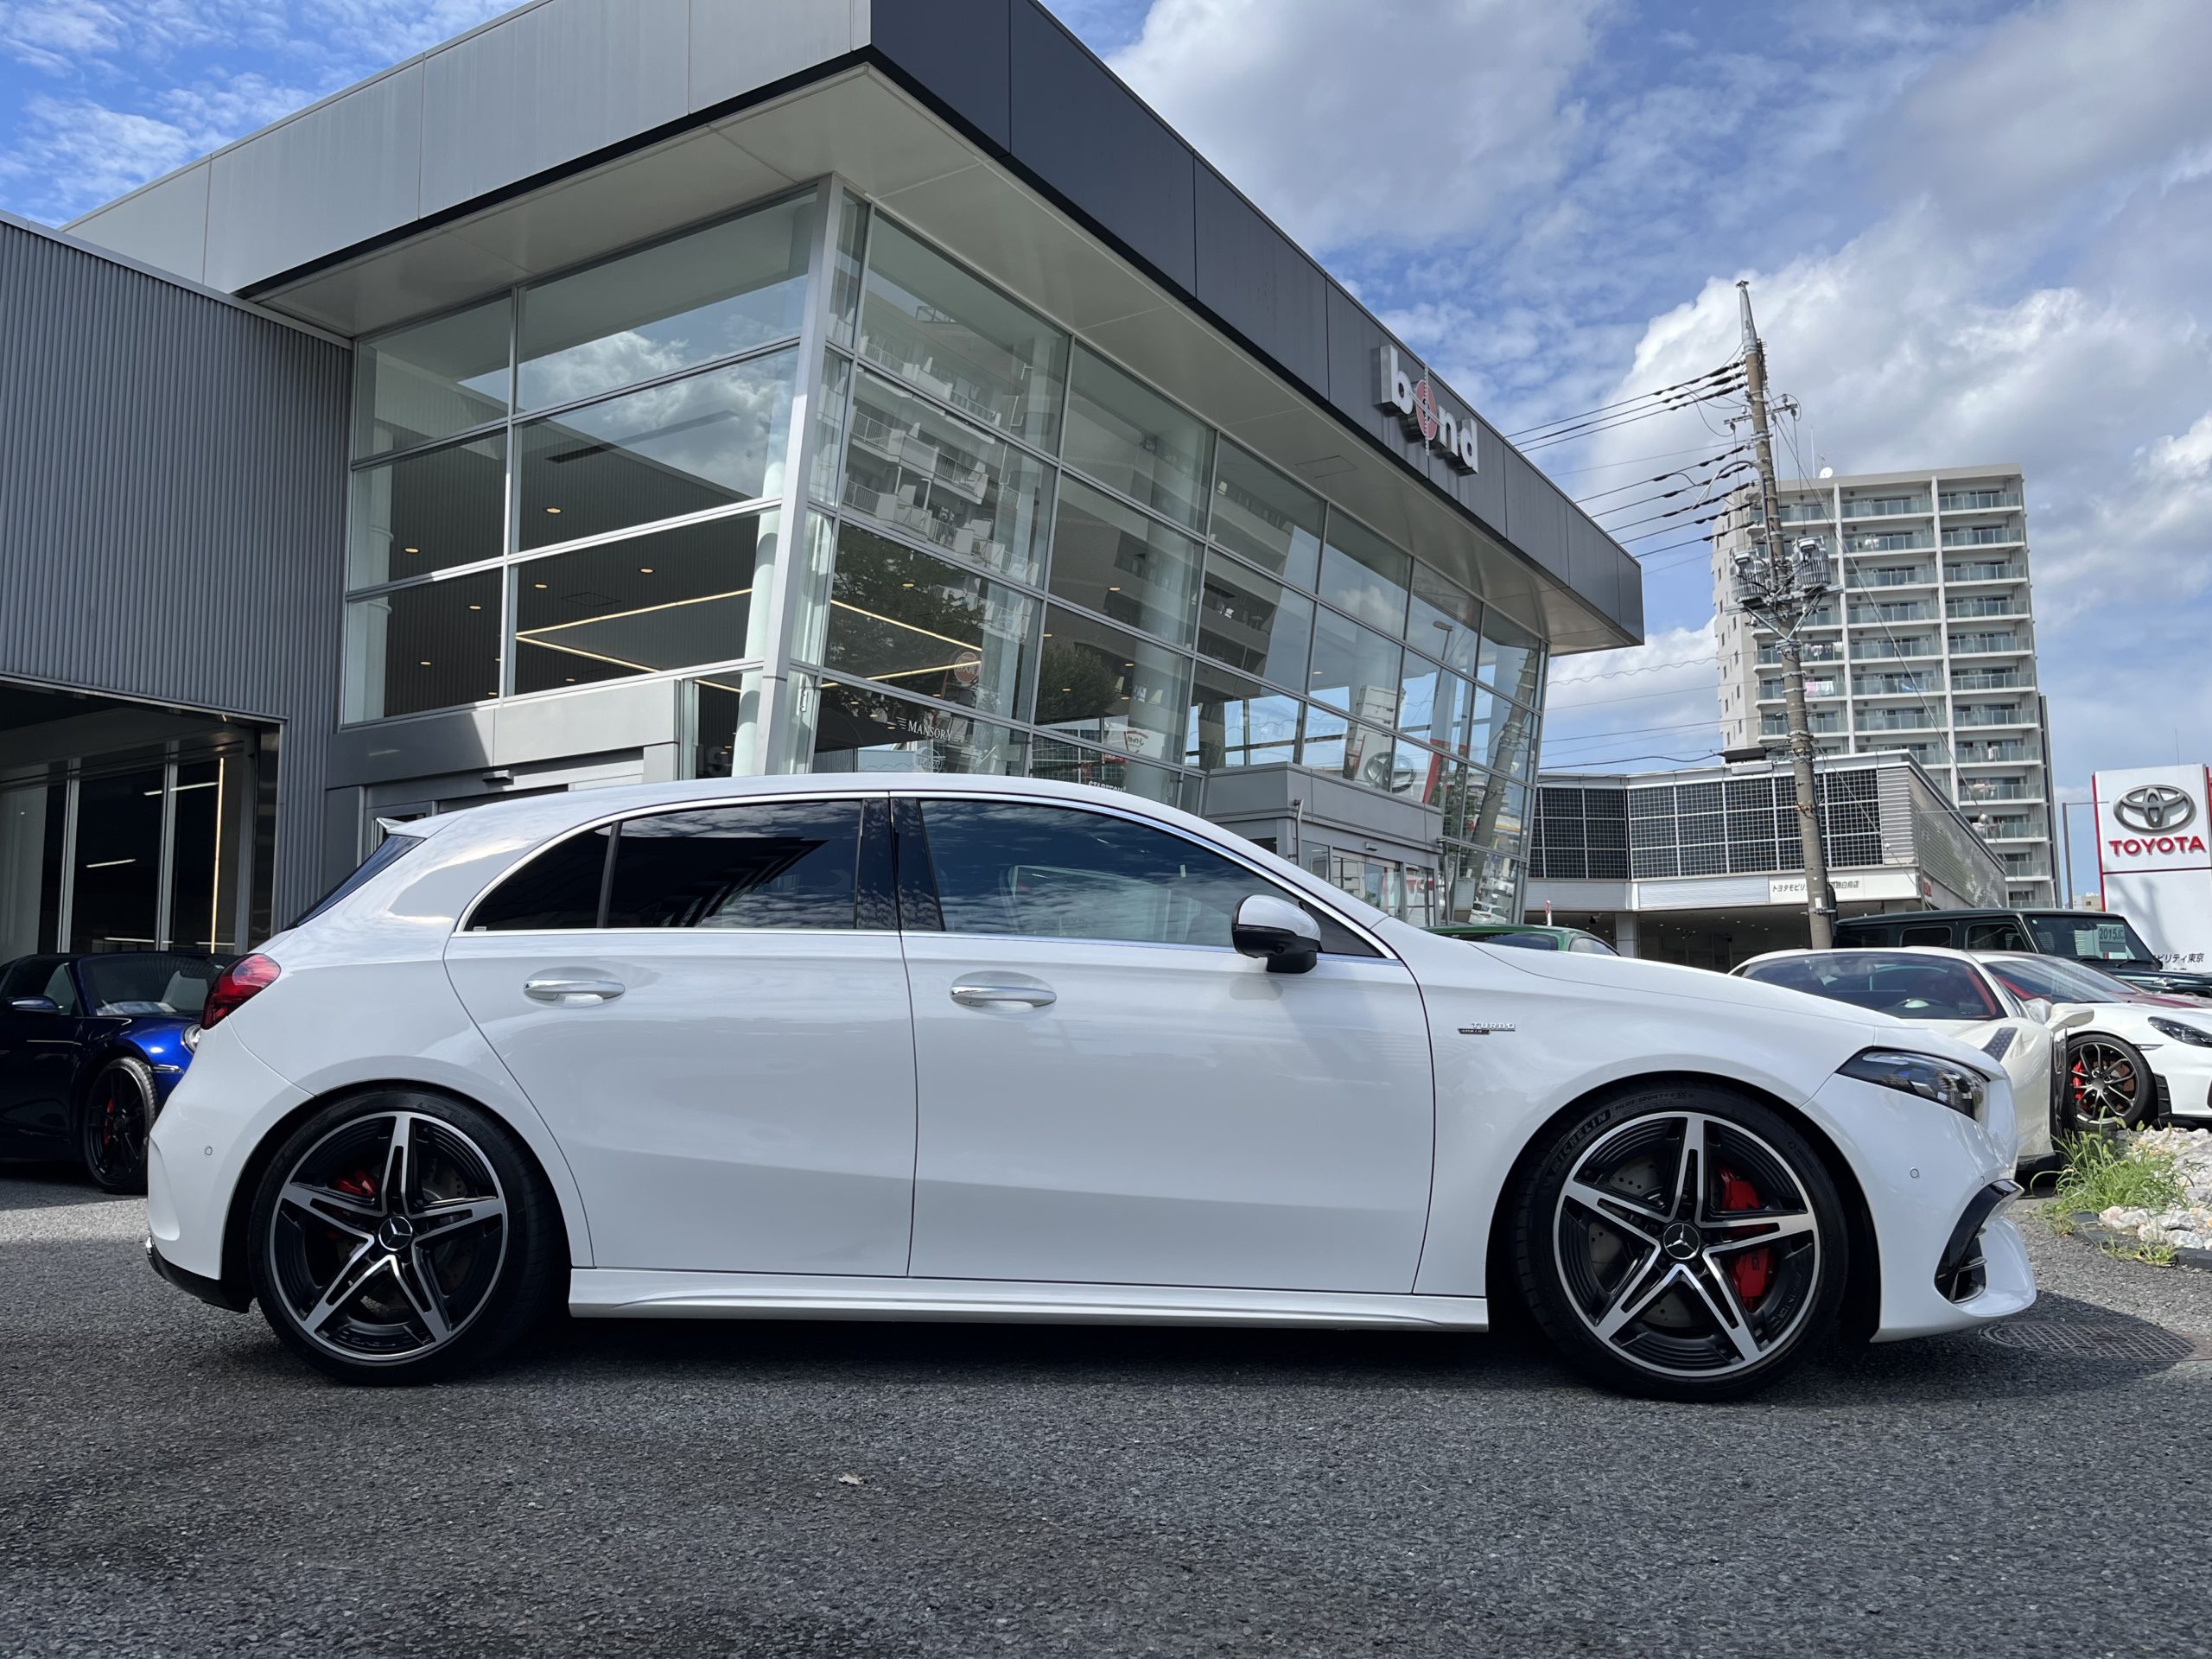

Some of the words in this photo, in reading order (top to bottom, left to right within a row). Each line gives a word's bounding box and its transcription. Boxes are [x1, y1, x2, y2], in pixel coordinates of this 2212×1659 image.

[1380, 344, 1478, 474] bond
[907, 719, 952, 741] MANSORY
[2108, 836, 2206, 856] TOYOTA
[1551, 1110, 1610, 1171] MICHELIN
